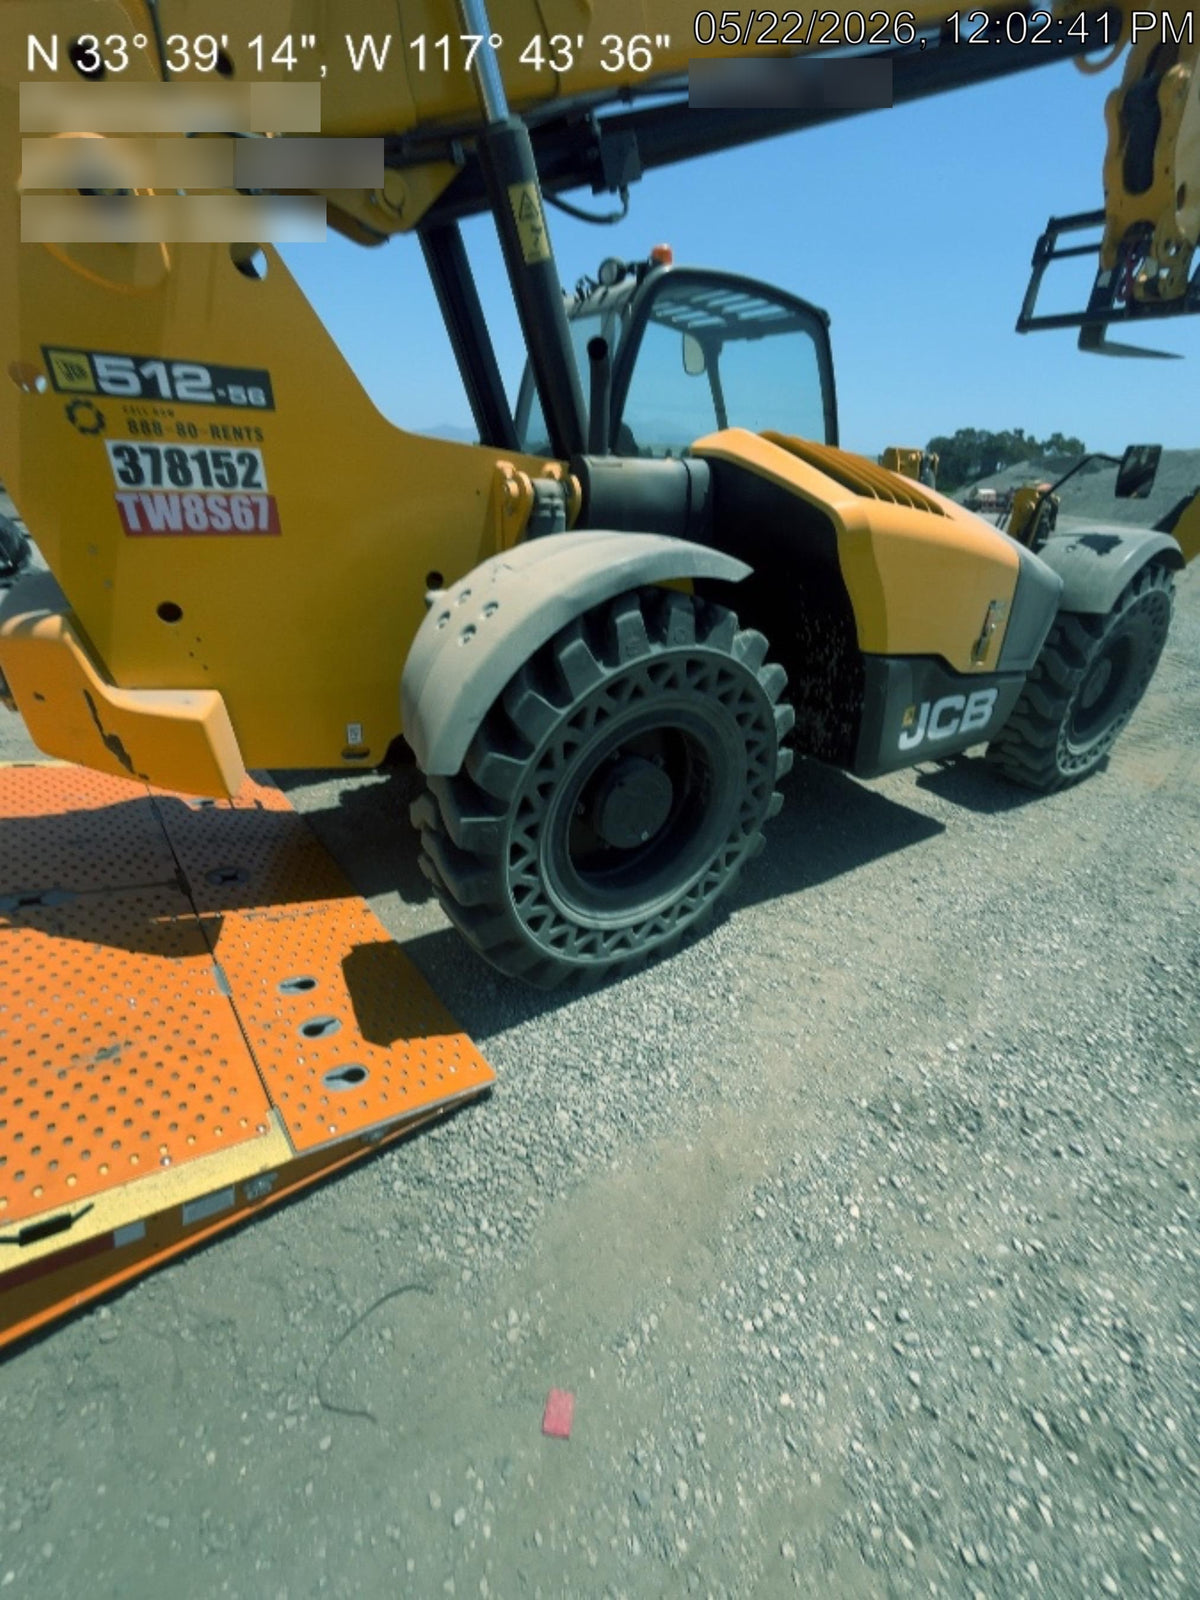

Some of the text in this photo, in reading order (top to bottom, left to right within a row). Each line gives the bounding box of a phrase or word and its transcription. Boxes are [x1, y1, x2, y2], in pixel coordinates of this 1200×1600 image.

[111, 445, 263, 490] 378152
[115, 492, 271, 532] TW8S67
[897, 687, 998, 751] JCB
